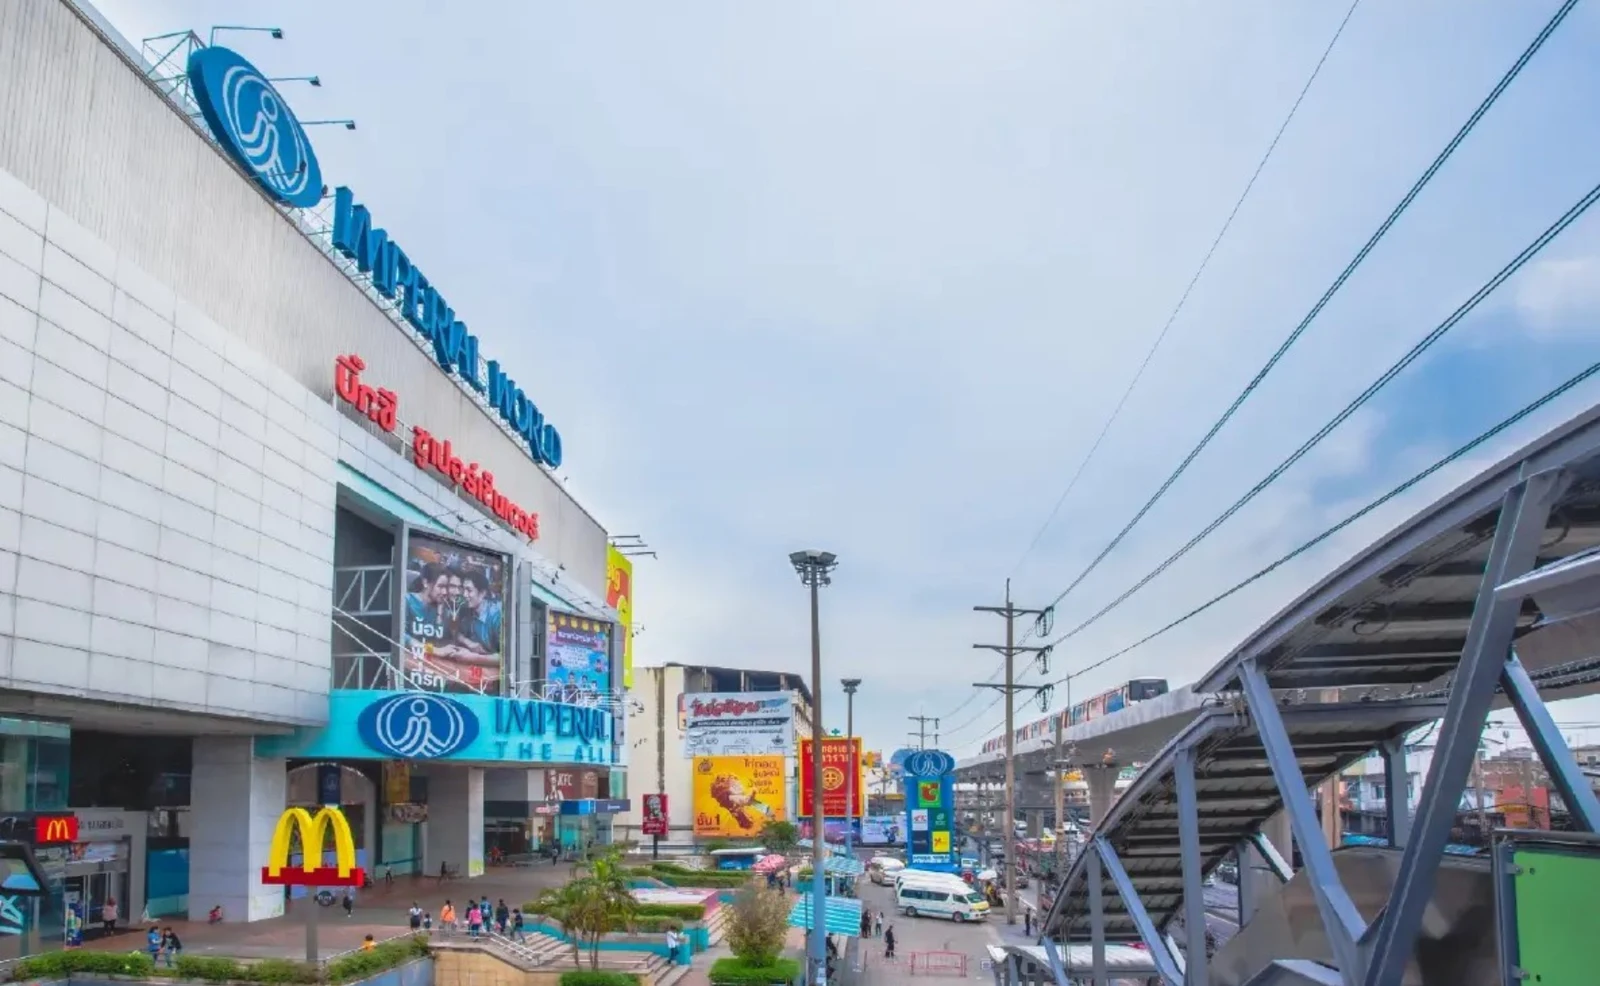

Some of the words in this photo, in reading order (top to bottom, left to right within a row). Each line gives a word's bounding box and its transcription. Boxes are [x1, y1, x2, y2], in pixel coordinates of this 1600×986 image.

[332, 185, 486, 395] IMPERIAL
[487, 359, 562, 469] WORLD
[412, 616, 444, 639] น้อง
[494, 698, 609, 745] IMPERIAL
[493, 740, 552, 760] THE
[574, 744, 606, 763] ALL
[557, 772, 573, 786] KFC
